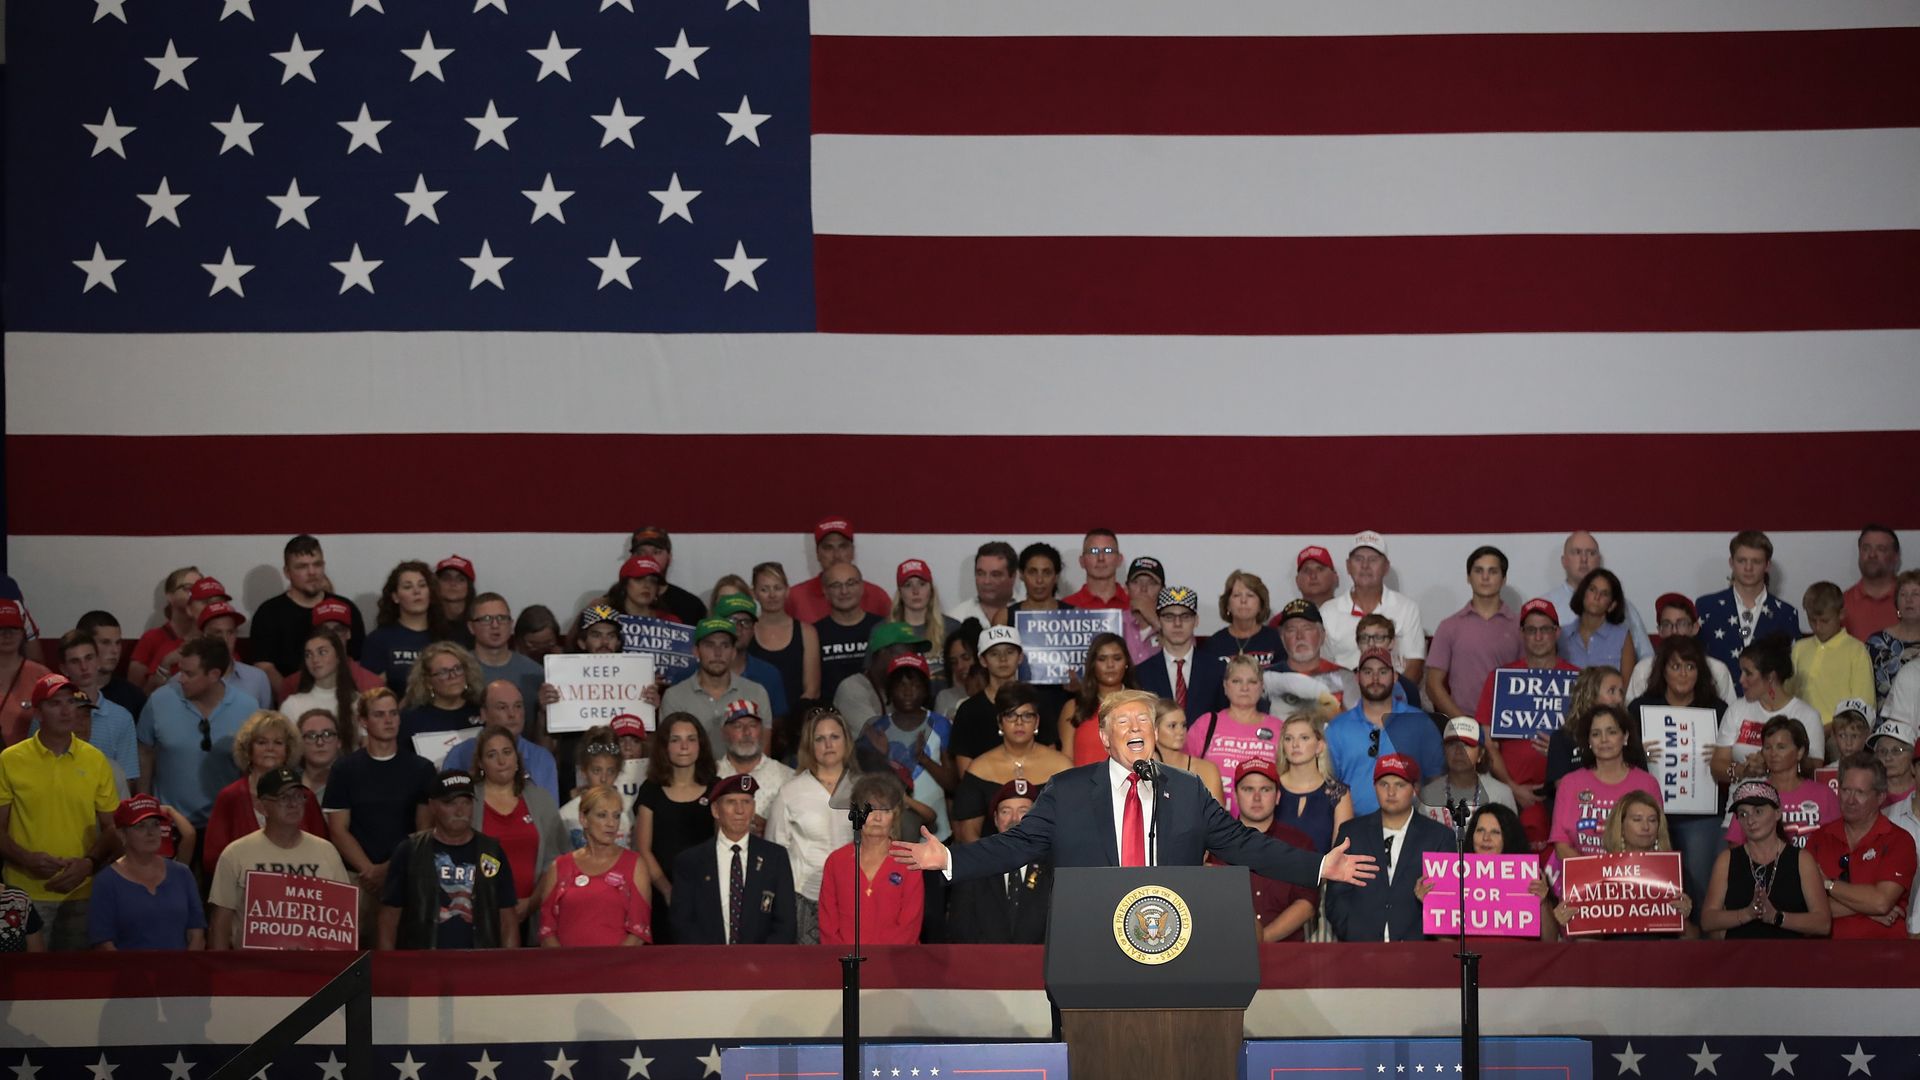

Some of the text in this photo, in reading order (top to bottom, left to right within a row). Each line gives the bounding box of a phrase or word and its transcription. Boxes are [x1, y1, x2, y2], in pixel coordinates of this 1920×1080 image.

[620, 622, 690, 643] ROMISES
[1027, 619, 1110, 633] PROMISES
[988, 629, 1012, 640] USA
[1044, 633, 1093, 646] MADE
[624, 634, 673, 651] MADE
[822, 642, 869, 655] TRUM
[393, 650, 422, 660] TRU
[654, 653, 690, 668] ISES
[1027, 650, 1089, 664] PROMIS
[582, 666, 621, 678] KEEP
[1509, 676, 1572, 697] DRAI
[1533, 697, 1563, 711] THE
[1846, 700, 1868, 714] USA
[579, 706, 627, 719] GREAT
[1499, 709, 1567, 730] SWAM
[1878, 725, 1900, 734] USA
[1214, 737, 1274, 751] TRUMP
[1223, 758, 1239, 768] 20
[1664, 715, 1678, 802] TRUMP
[1679, 723, 1689, 795] PENCE
[441, 775, 472, 788] TRUMP
[1578, 803, 1613, 821] Tru
[1578, 832, 1602, 846] Pen
[1791, 836, 1807, 848] 20
[1425, 859, 1538, 879] WOMEN
[1602, 864, 1641, 878] MAKE
[285, 886, 323, 901] MAKE
[1568, 880, 1677, 903] AMERICA
[248, 899, 355, 929] AMERICA
[1116, 889, 1149, 924] PRESIDENT
[1172, 897, 1190, 930] UNITED
[1579, 903, 1677, 919] ROUD AGAIN
[1430, 908, 1534, 930] TRUMP
[250, 921, 352, 944] PROUD AGAIN
[1126, 945, 1146, 960] SEAL
[1161, 936, 1187, 960] STATES
